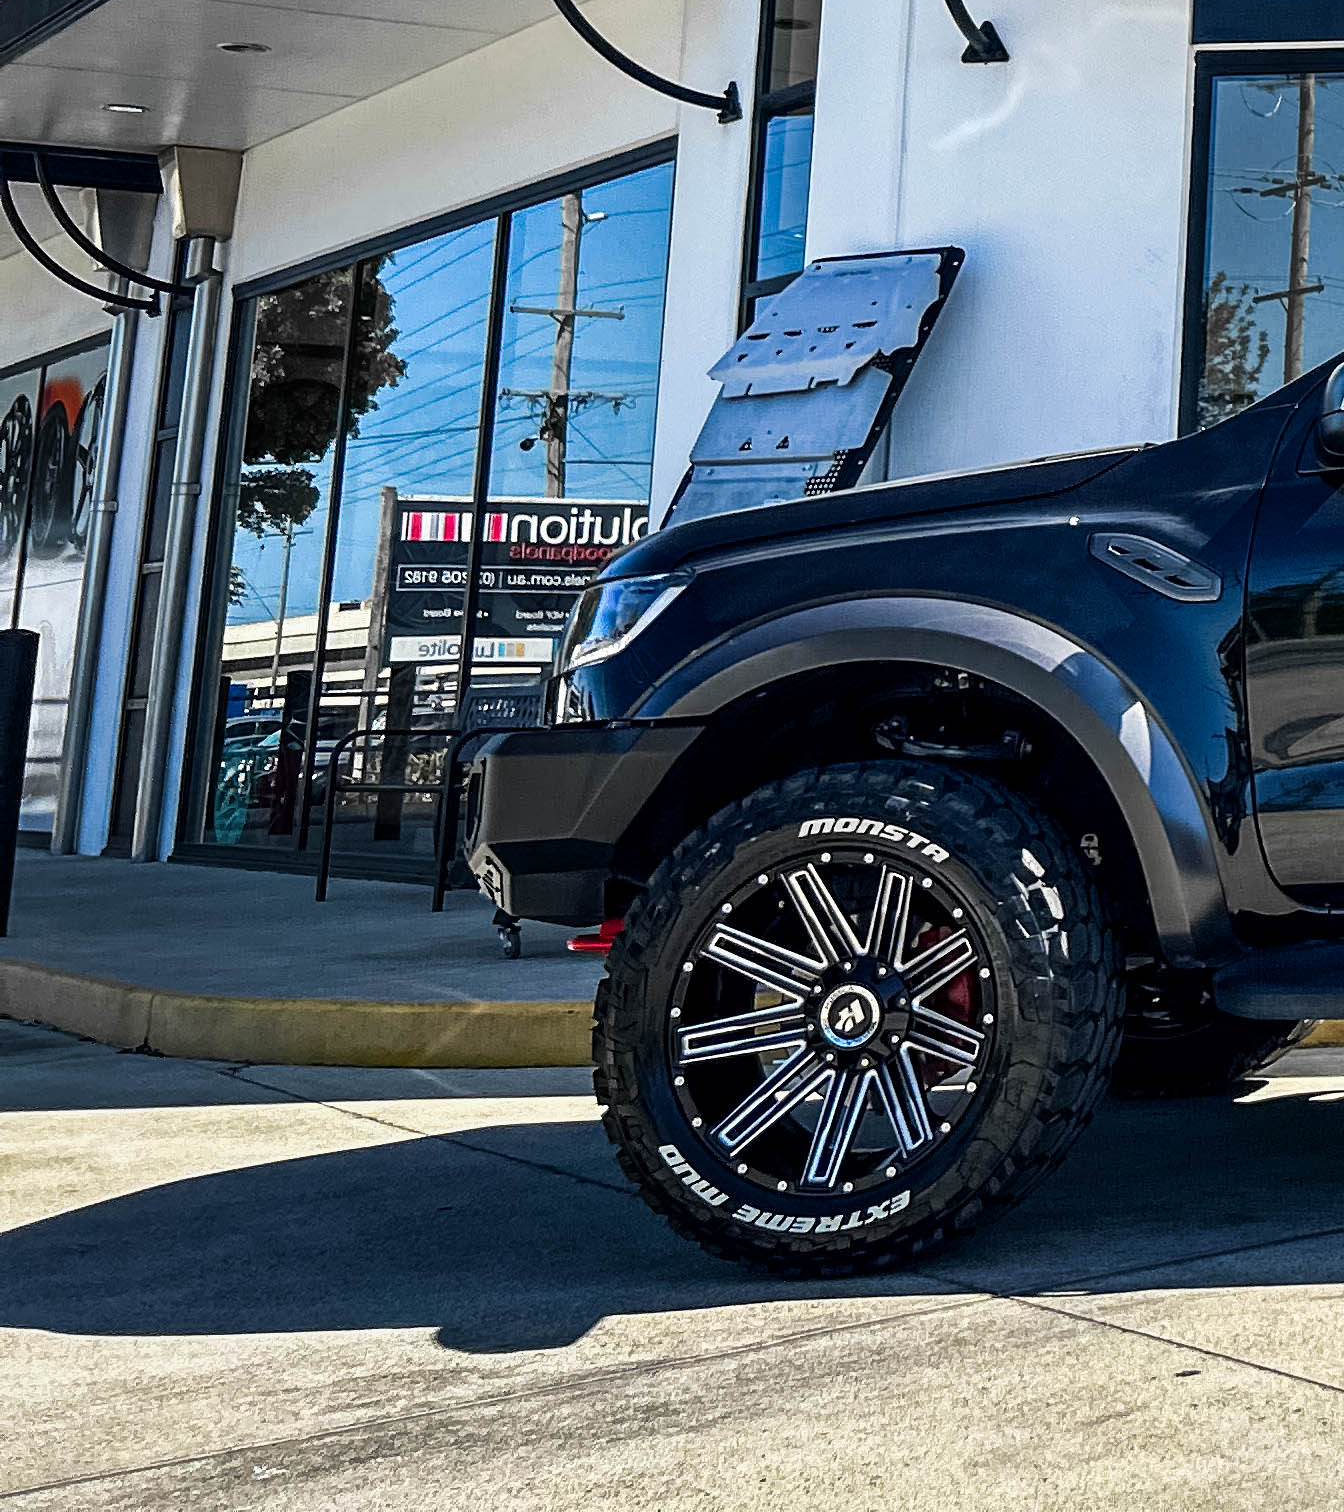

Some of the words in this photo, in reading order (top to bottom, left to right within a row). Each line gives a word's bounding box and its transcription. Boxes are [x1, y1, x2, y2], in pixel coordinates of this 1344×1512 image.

[798, 817, 950, 863] MONSTA
[659, 1144, 729, 1207] MUD
[732, 1190, 911, 1233] EXTREME
